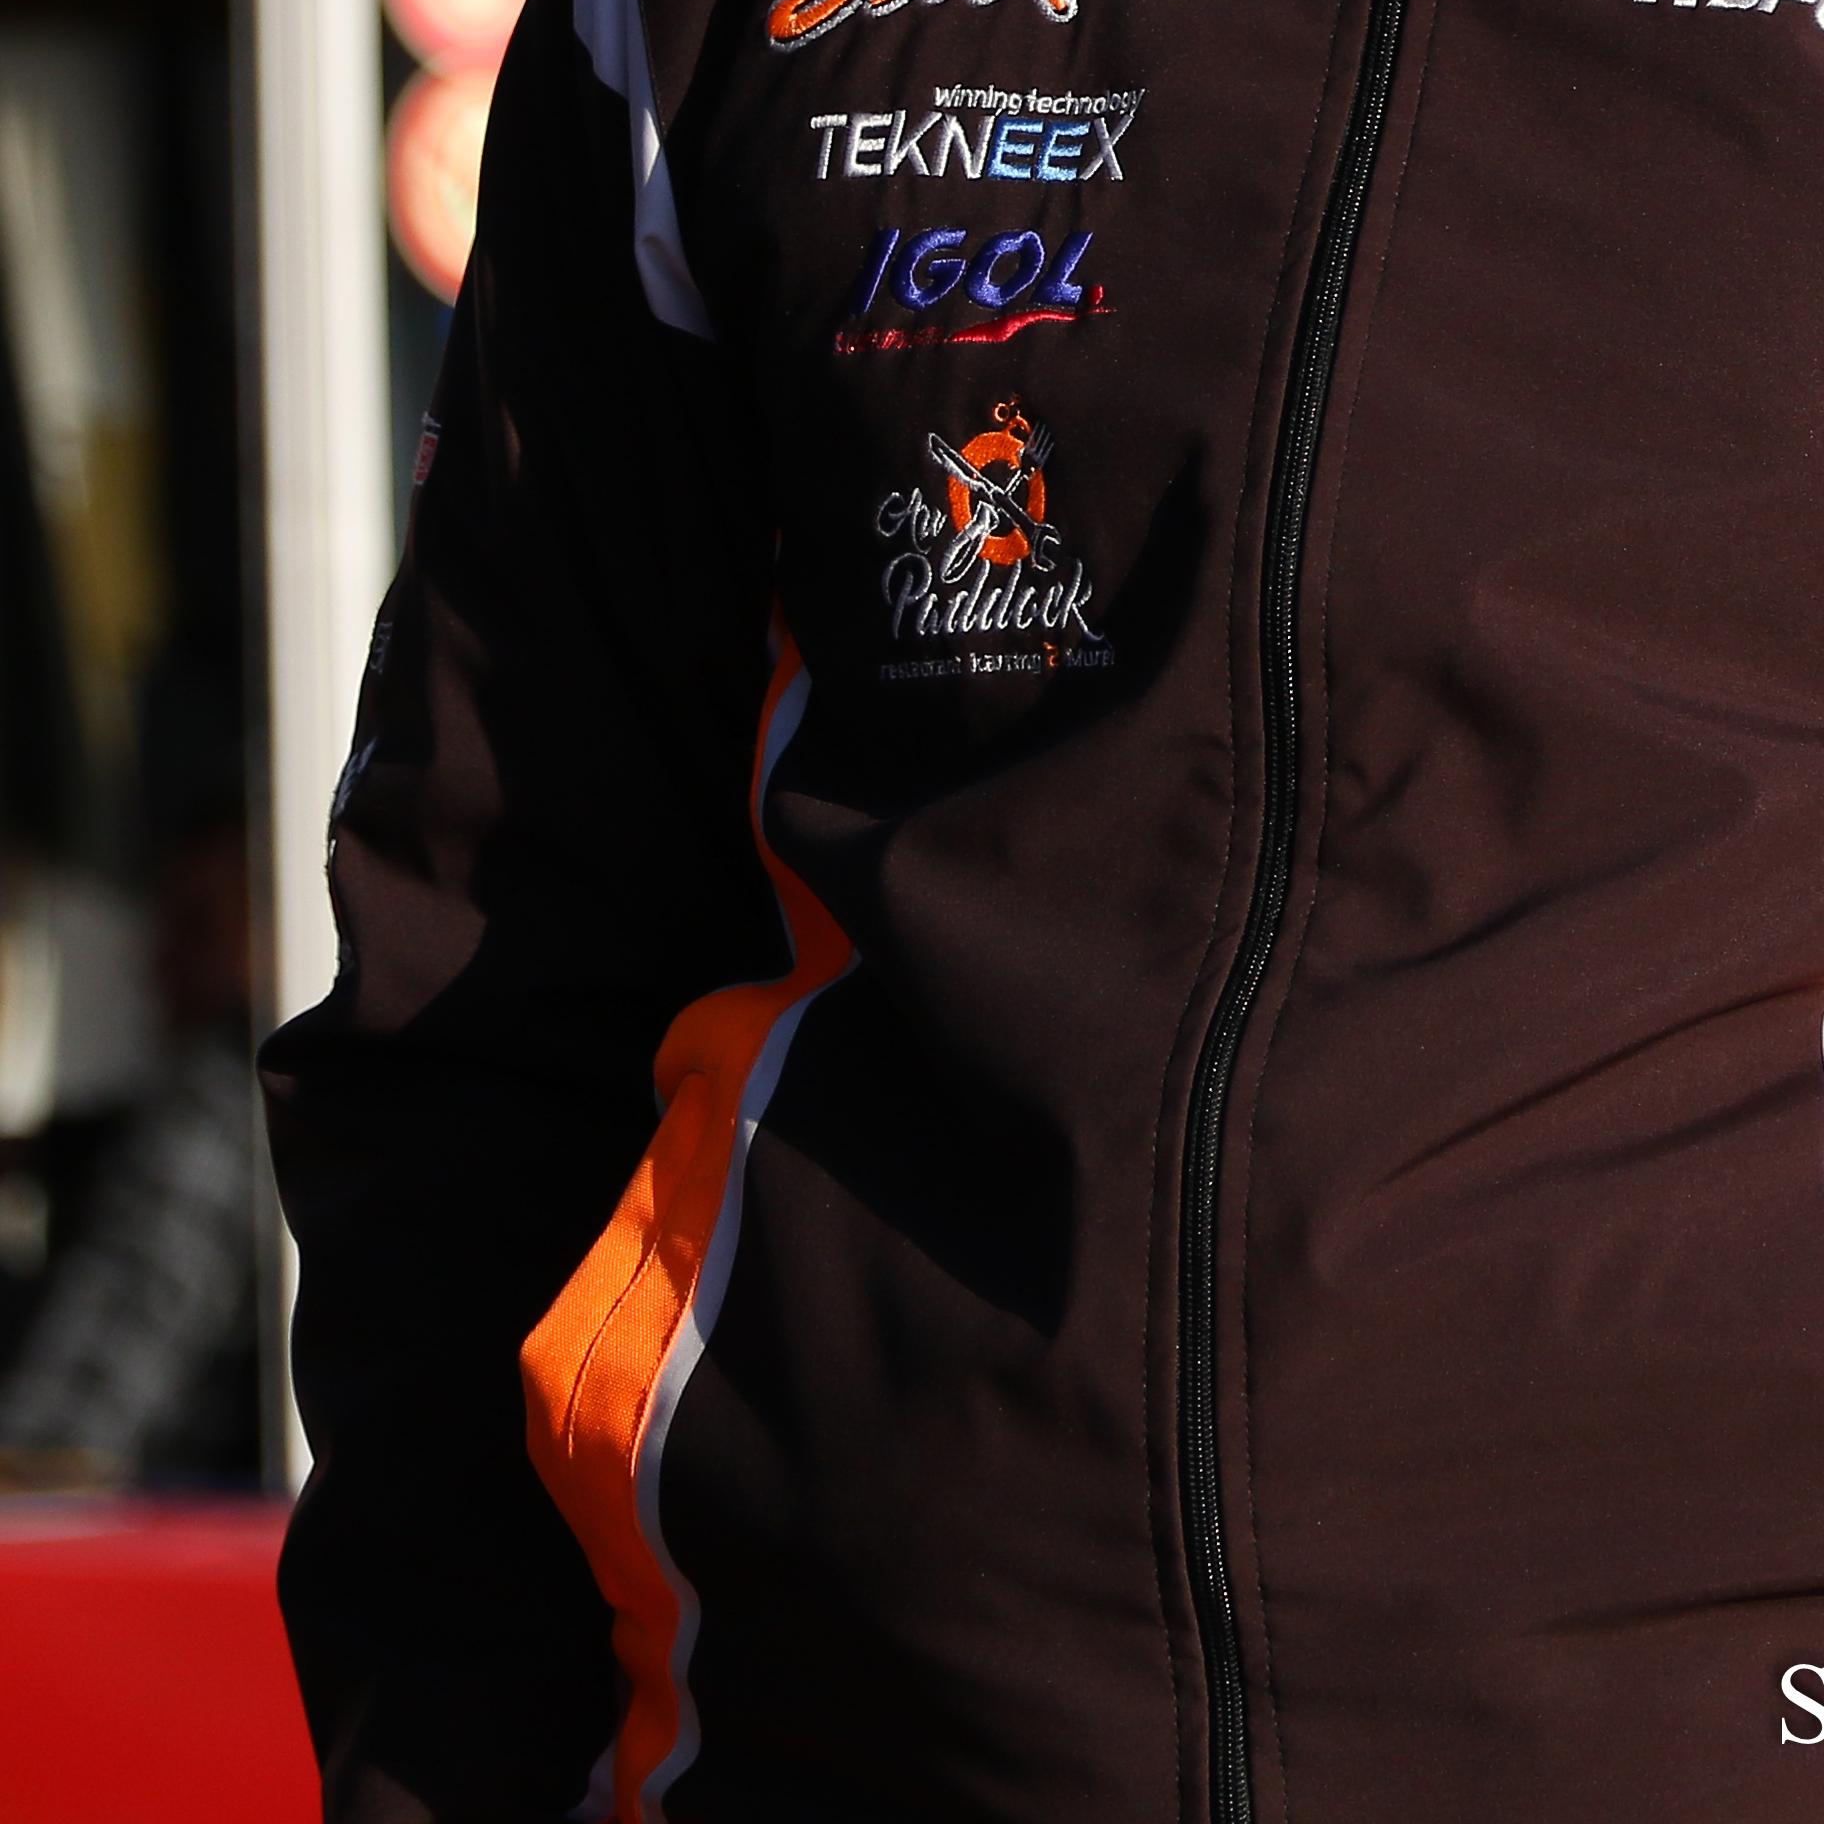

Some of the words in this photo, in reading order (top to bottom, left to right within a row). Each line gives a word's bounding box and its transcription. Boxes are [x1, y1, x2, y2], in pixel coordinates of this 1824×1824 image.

[934, 84, 1023, 116] winning
[1026, 87, 1145, 118] technology
[810, 110, 1135, 181] TEKNEEX
[850, 229, 1094, 314] IGOL
